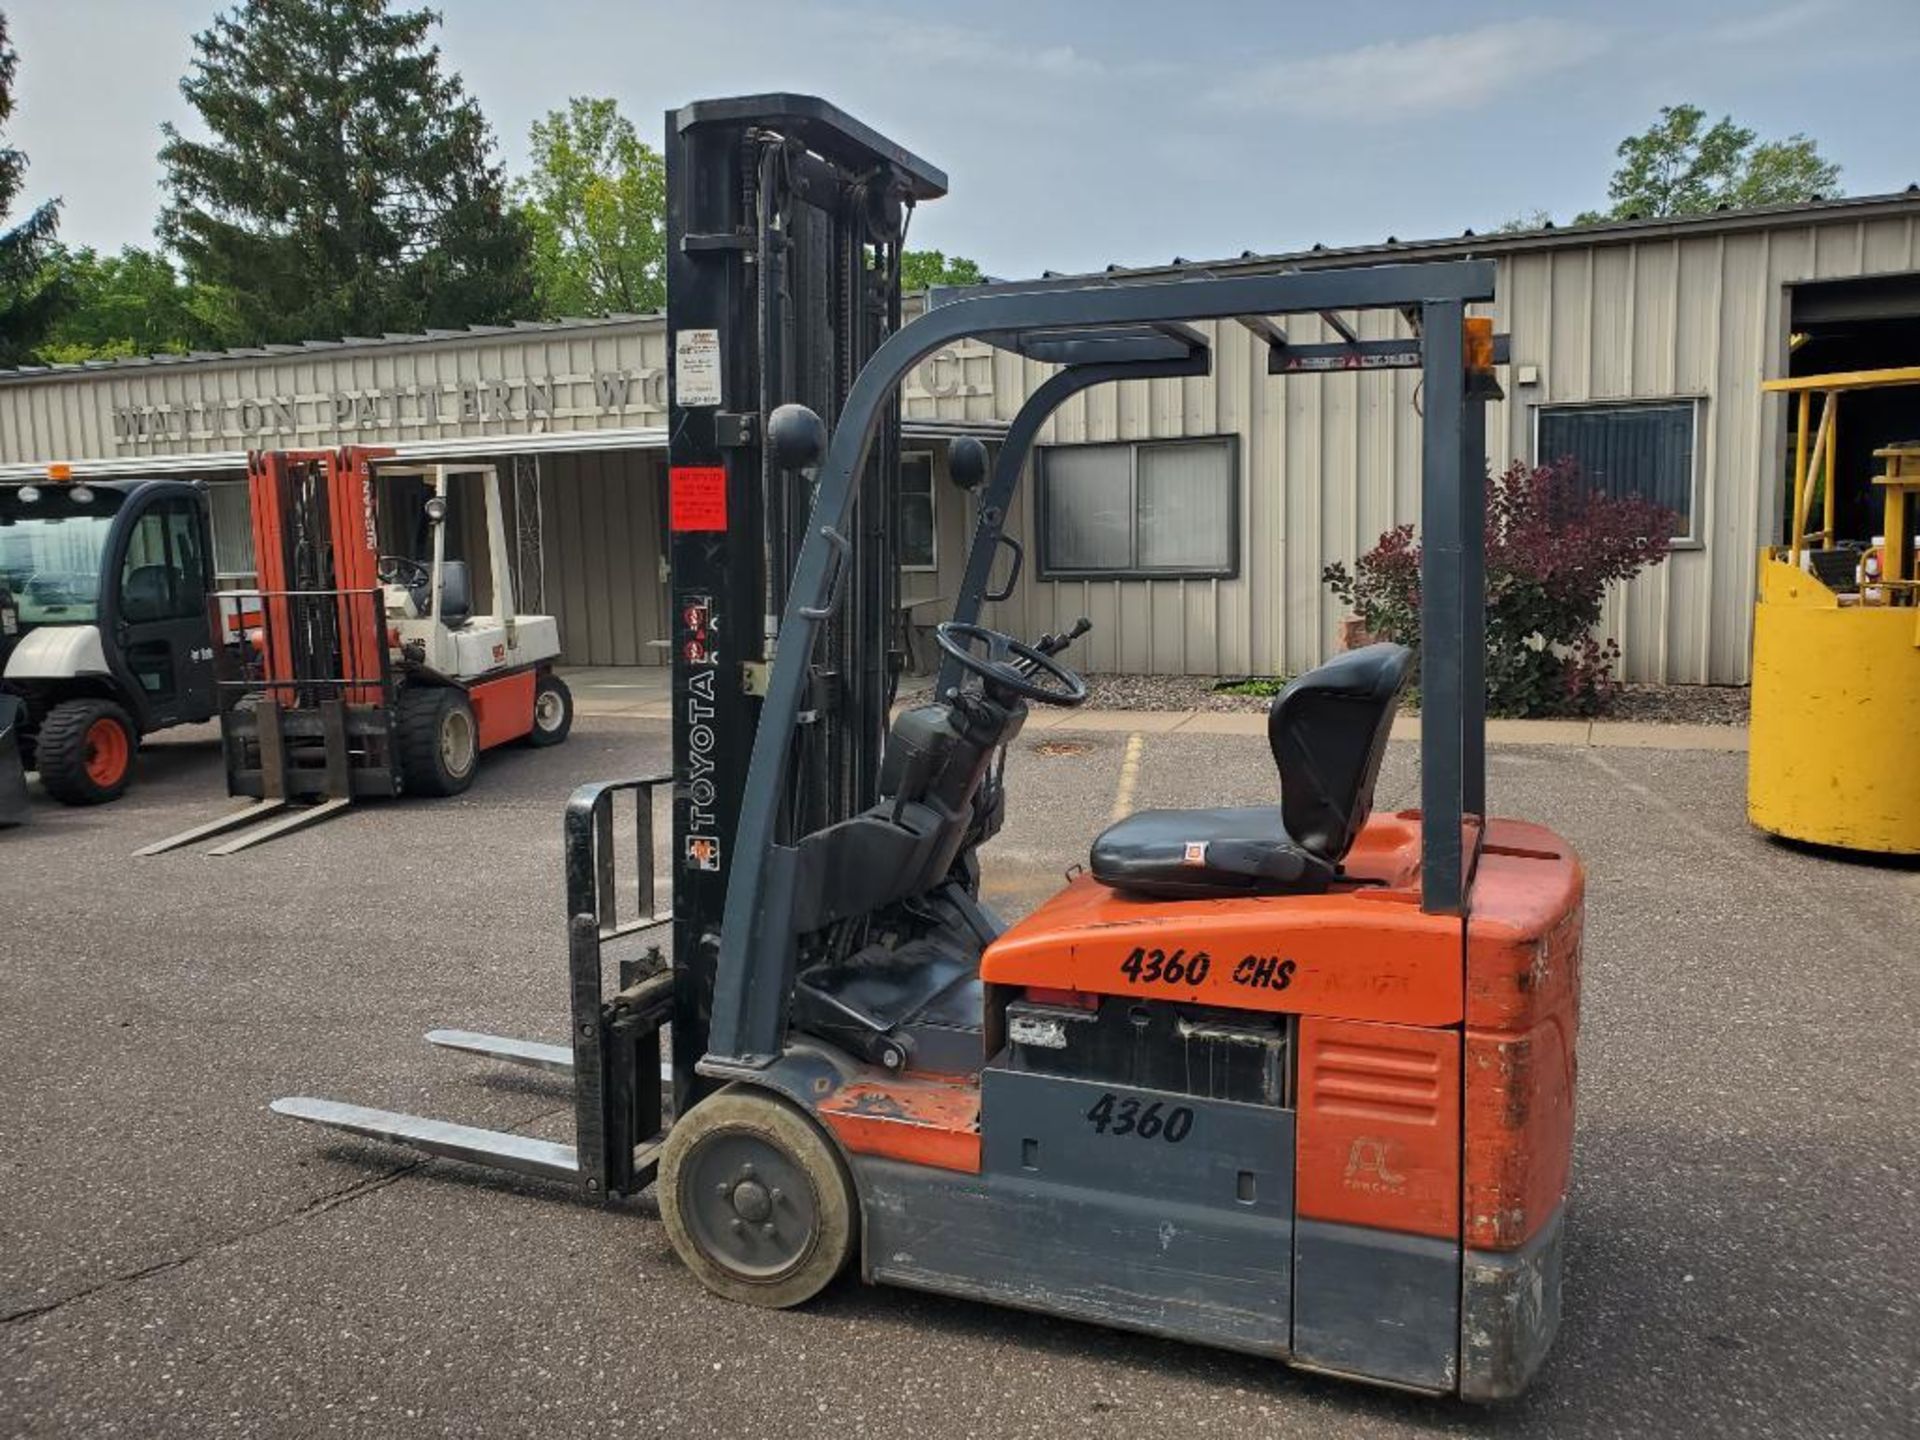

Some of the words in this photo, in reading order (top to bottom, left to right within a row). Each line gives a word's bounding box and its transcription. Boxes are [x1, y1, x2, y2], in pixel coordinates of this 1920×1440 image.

[330, 376, 554, 429] PATTERN
[689, 670, 715, 831] TOYOTA
[1121, 947, 1210, 986] 4360
[1233, 956, 1296, 991] CHS
[1086, 1093, 1194, 1143] 4360
